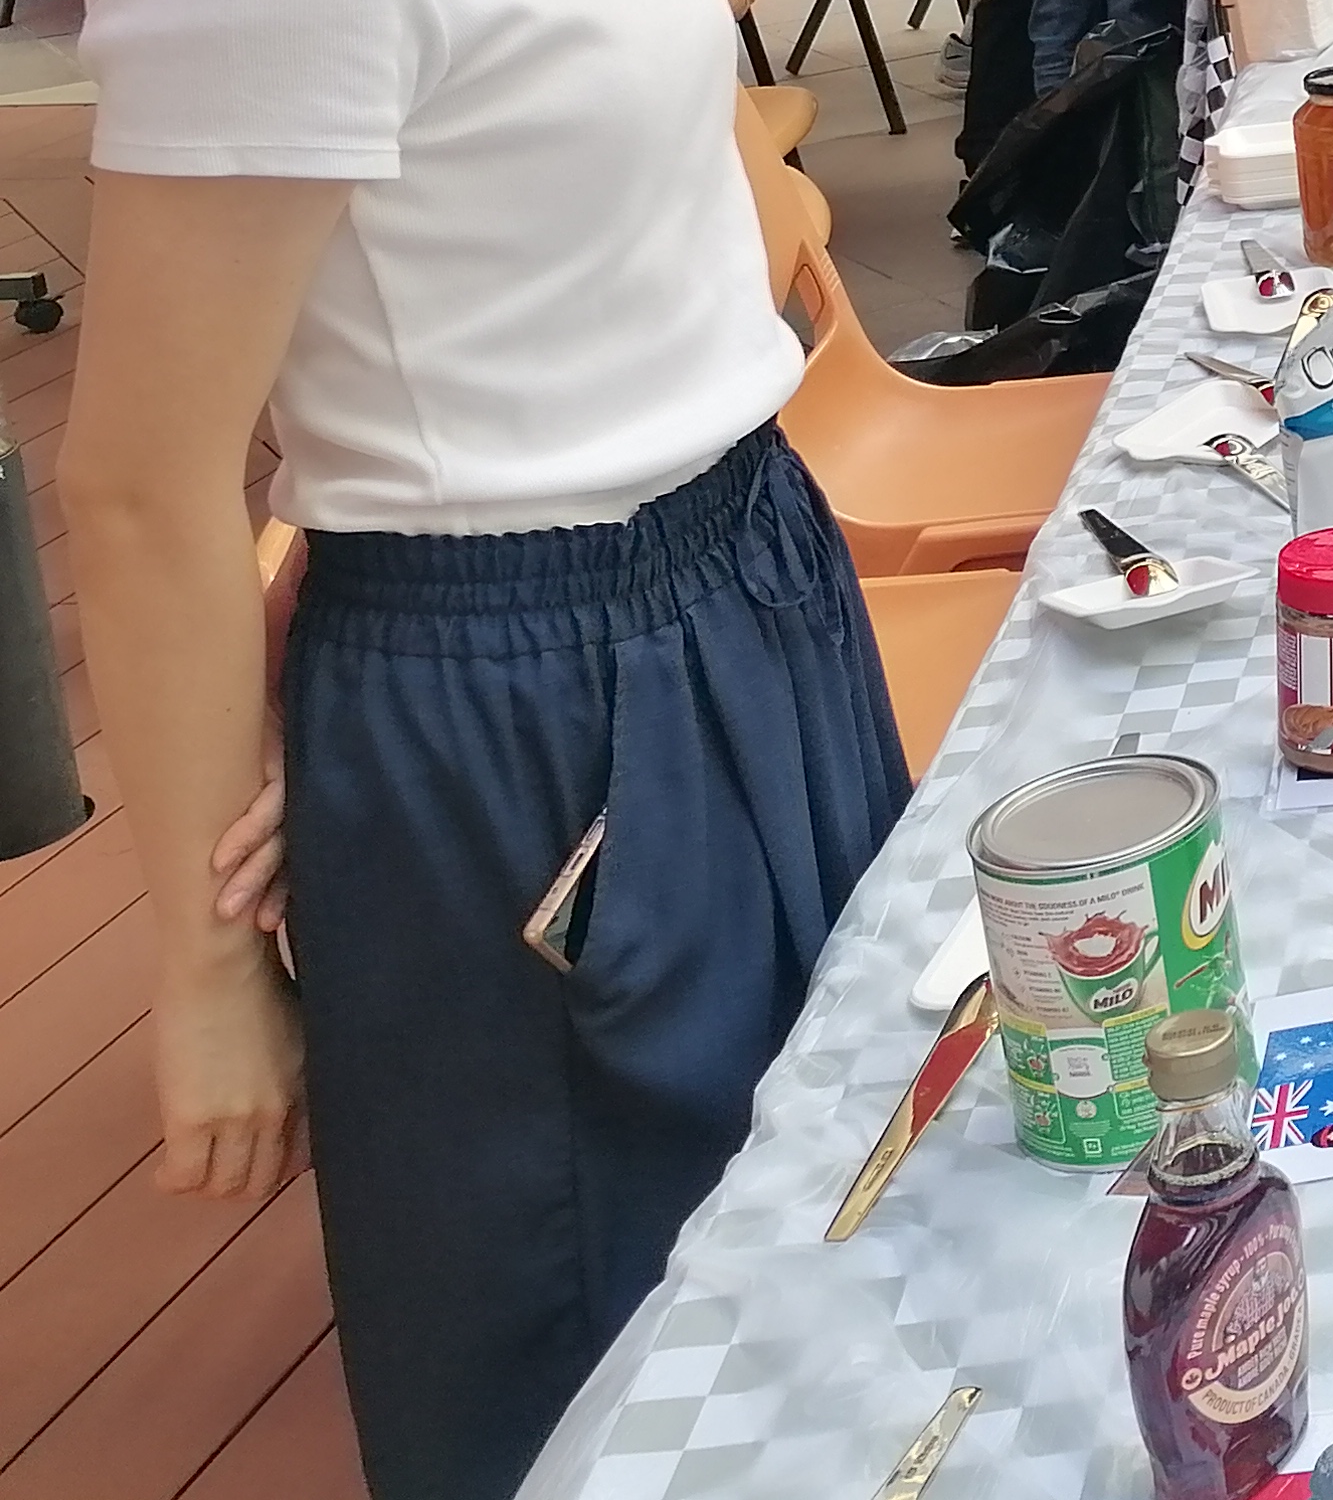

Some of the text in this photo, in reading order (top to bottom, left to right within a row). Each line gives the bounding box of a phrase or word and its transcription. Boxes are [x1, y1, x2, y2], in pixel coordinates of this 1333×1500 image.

[1121, 882, 1145, 898] DRINK
[1093, 987, 1133, 1011] MILO
[1216, 1259, 1242, 1292] syrup
[1195, 1292, 1221, 1330] maple
[1187, 1331, 1206, 1360] Pure
[1203, 1388, 1244, 1415] PRODUCT
[1245, 1396, 1258, 1412] OF
[1257, 1365, 1289, 1406] CANADA
